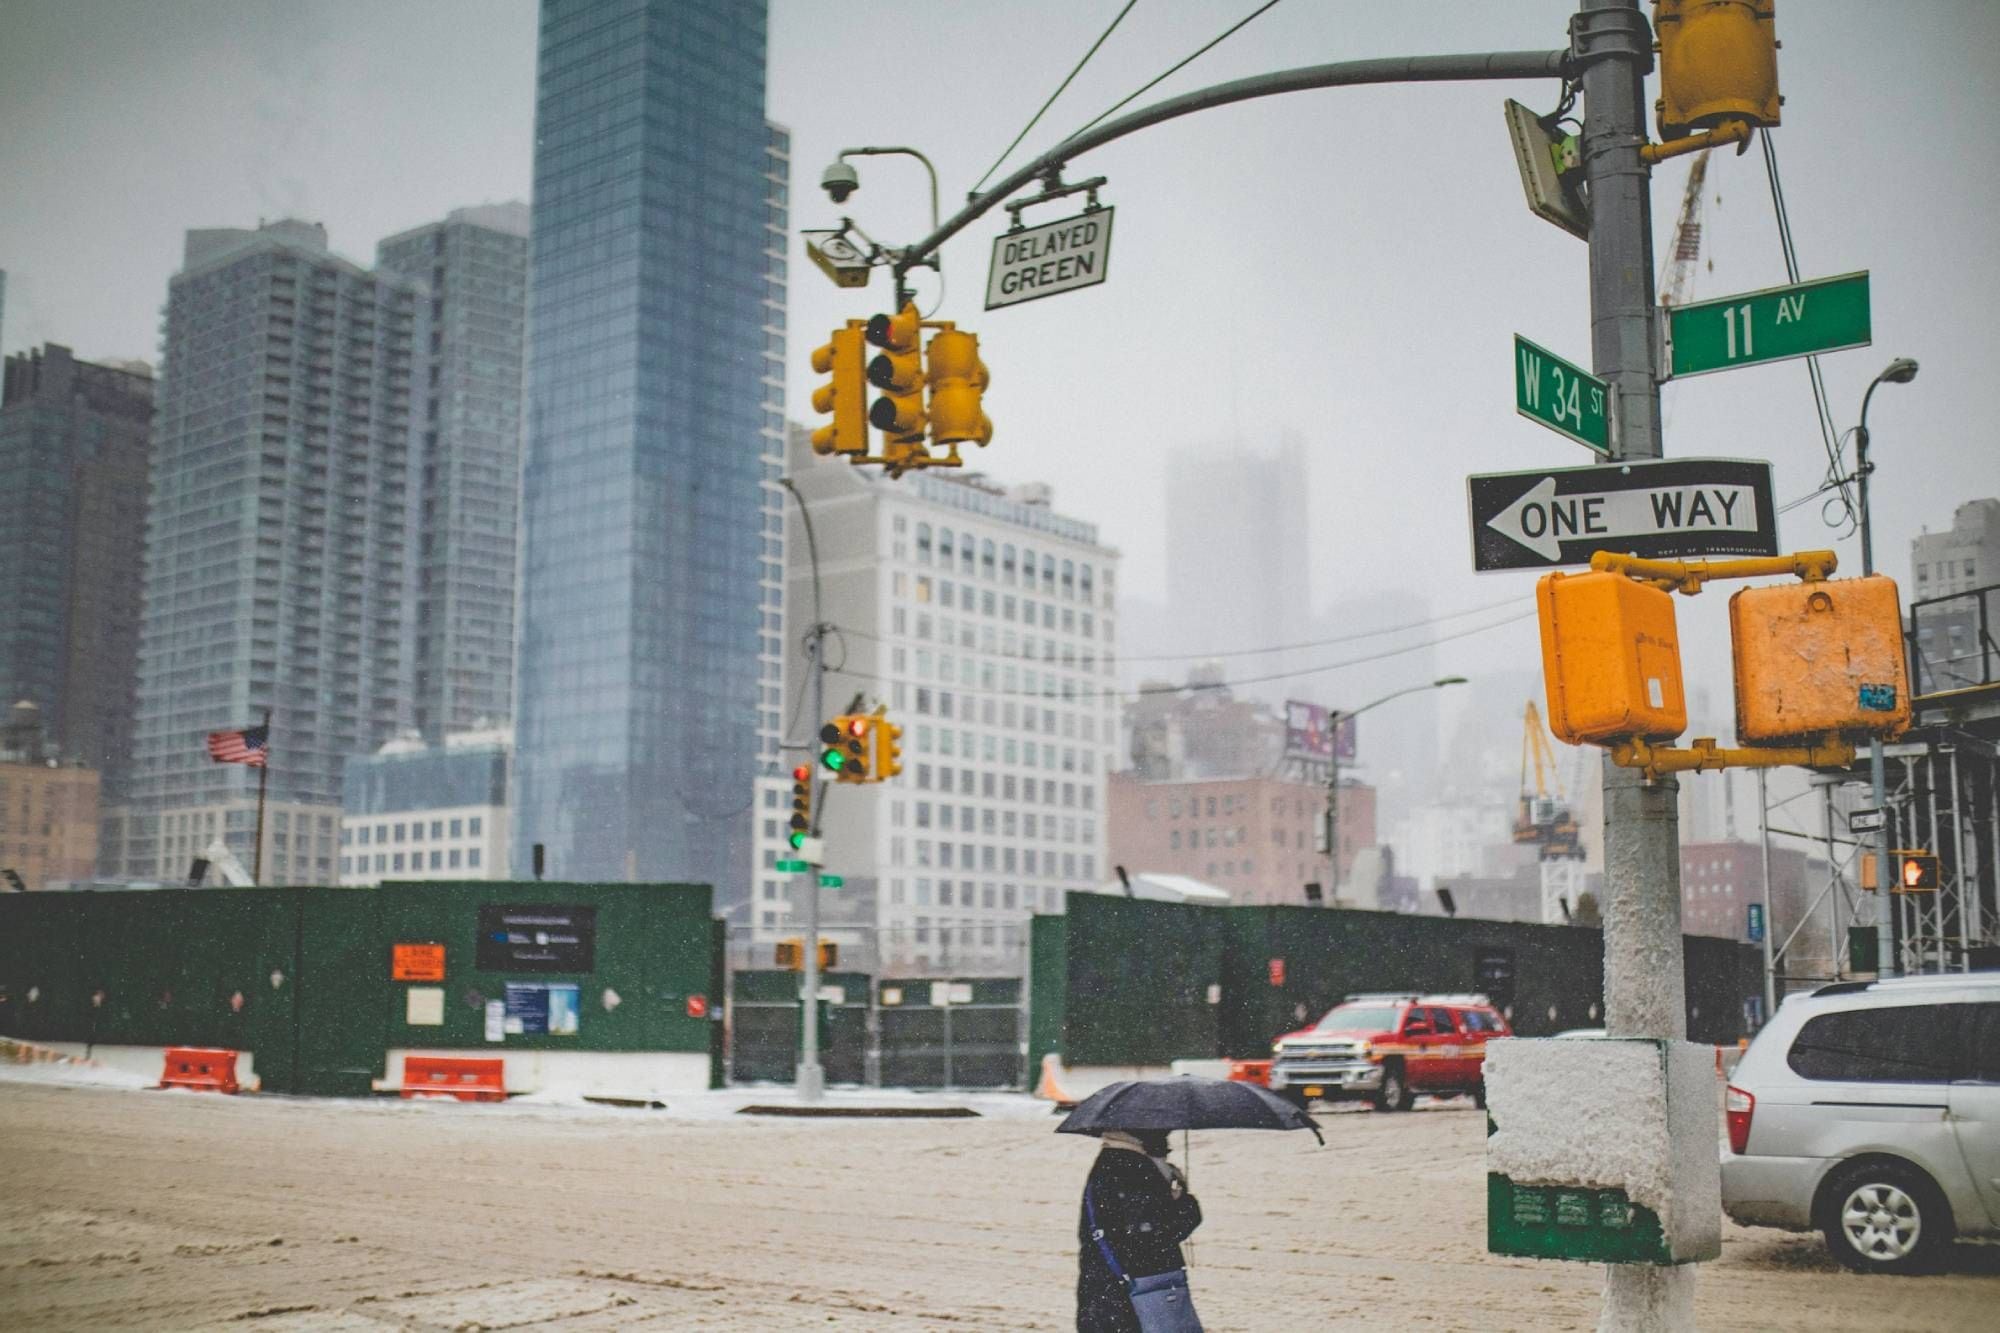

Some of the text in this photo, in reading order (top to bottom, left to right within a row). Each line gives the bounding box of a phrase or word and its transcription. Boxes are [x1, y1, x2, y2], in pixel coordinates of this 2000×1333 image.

[1003, 222, 1099, 266] DELAYED
[1001, 251, 1095, 295] GREEN
[1723, 294, 1805, 359] 11 AV
[1522, 348, 1604, 431] W 34 ST
[1520, 490, 1739, 538] ONE WAY
